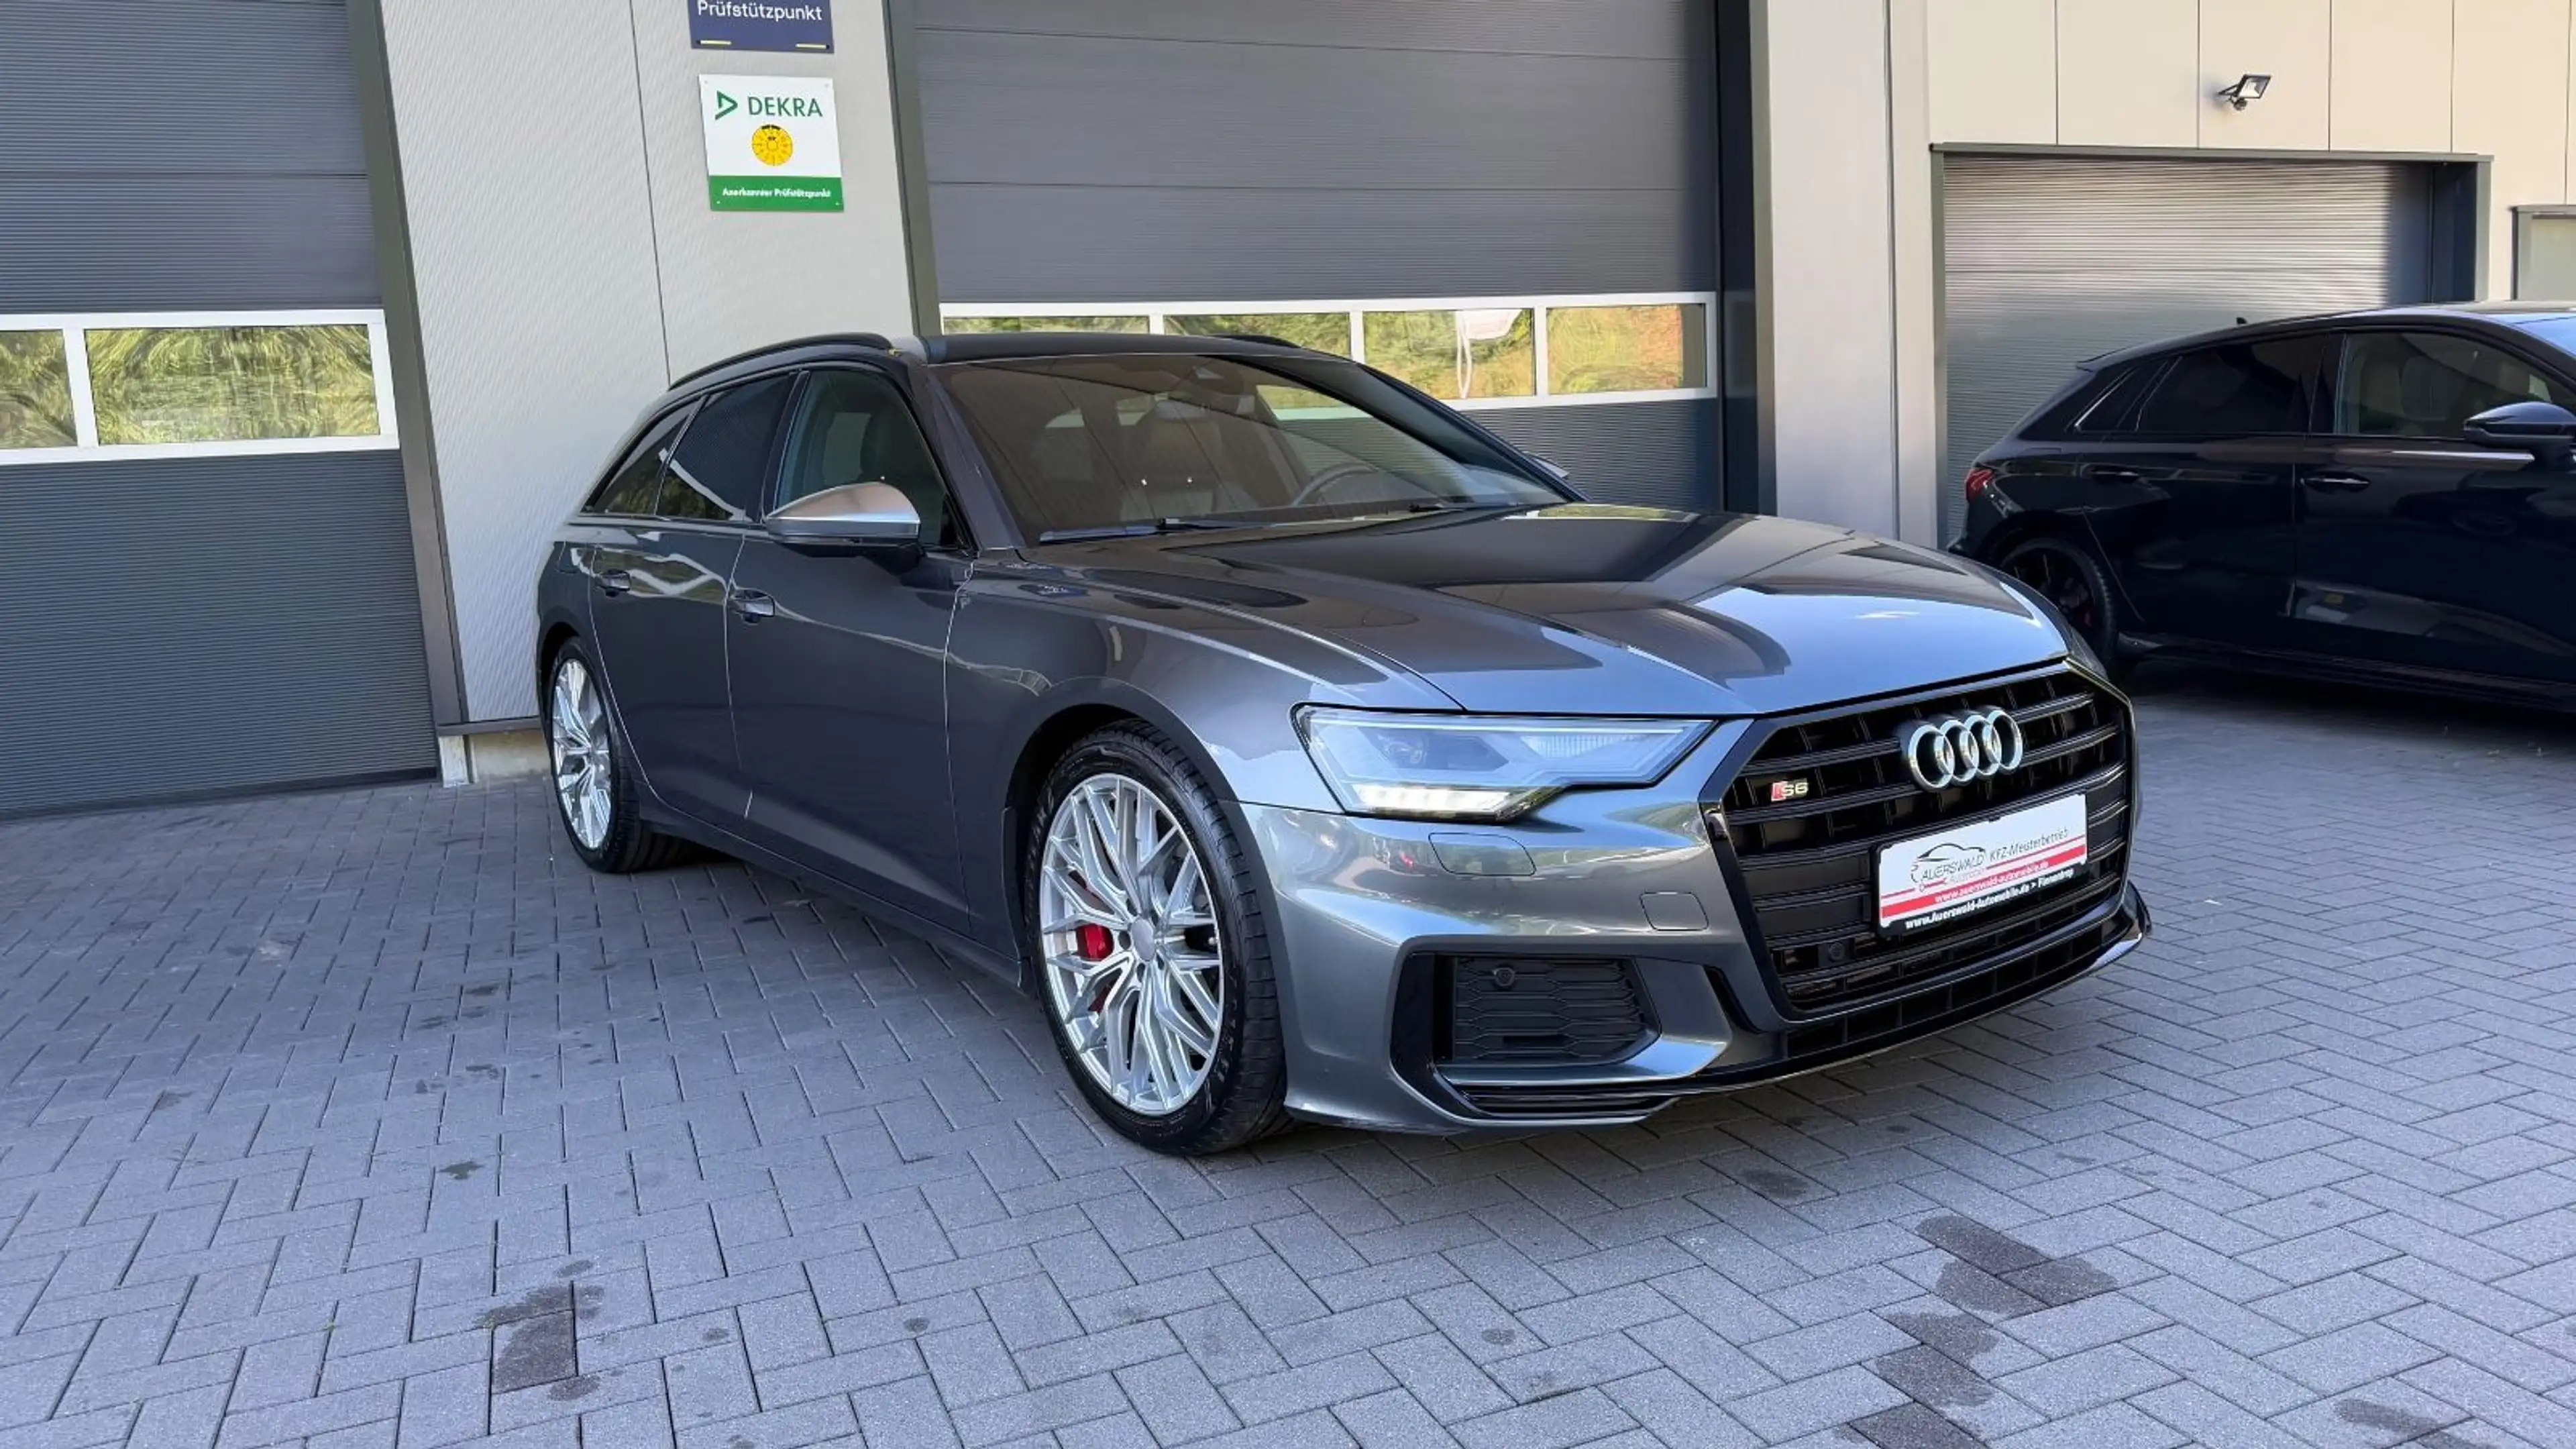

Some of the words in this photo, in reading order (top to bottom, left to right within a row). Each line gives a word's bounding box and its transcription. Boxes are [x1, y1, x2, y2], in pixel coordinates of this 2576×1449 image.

[698, 1, 822, 21] Prüfstützpunkt
[747, 96, 823, 117] DEKRA
[774, 188, 831, 199] Prüfstützpunkt
[1782, 782, 1809, 798] S6
[1921, 853, 1985, 880] AUERSWALD
